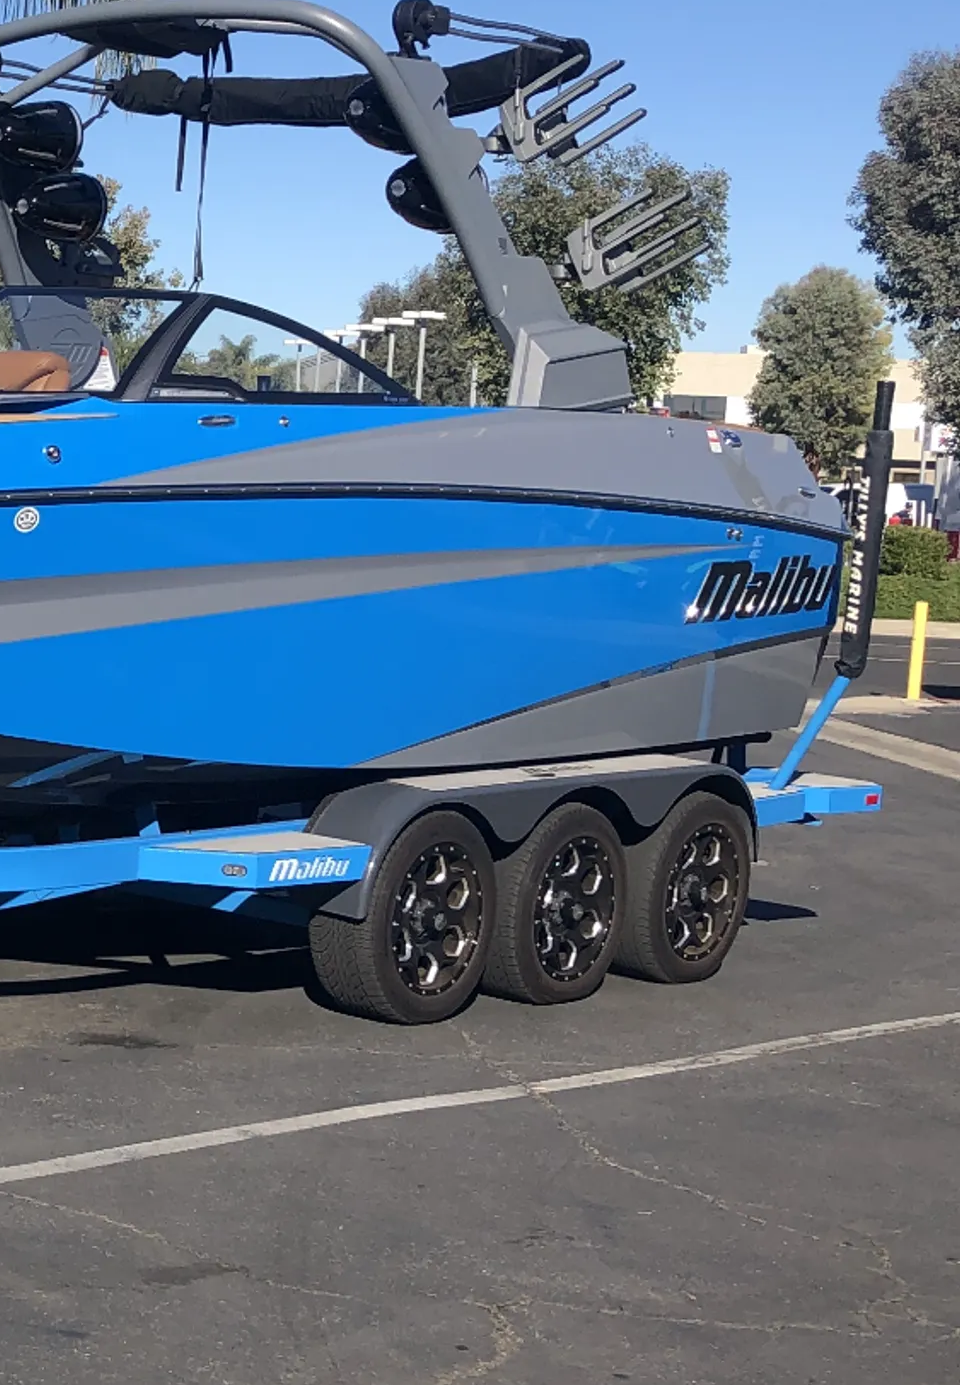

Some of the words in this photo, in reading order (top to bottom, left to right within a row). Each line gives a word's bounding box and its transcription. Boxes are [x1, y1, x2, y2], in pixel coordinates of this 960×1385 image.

[685, 555, 836, 624] Malibu
[844, 550, 864, 635] MARINE
[269, 855, 350, 882] Malibu
